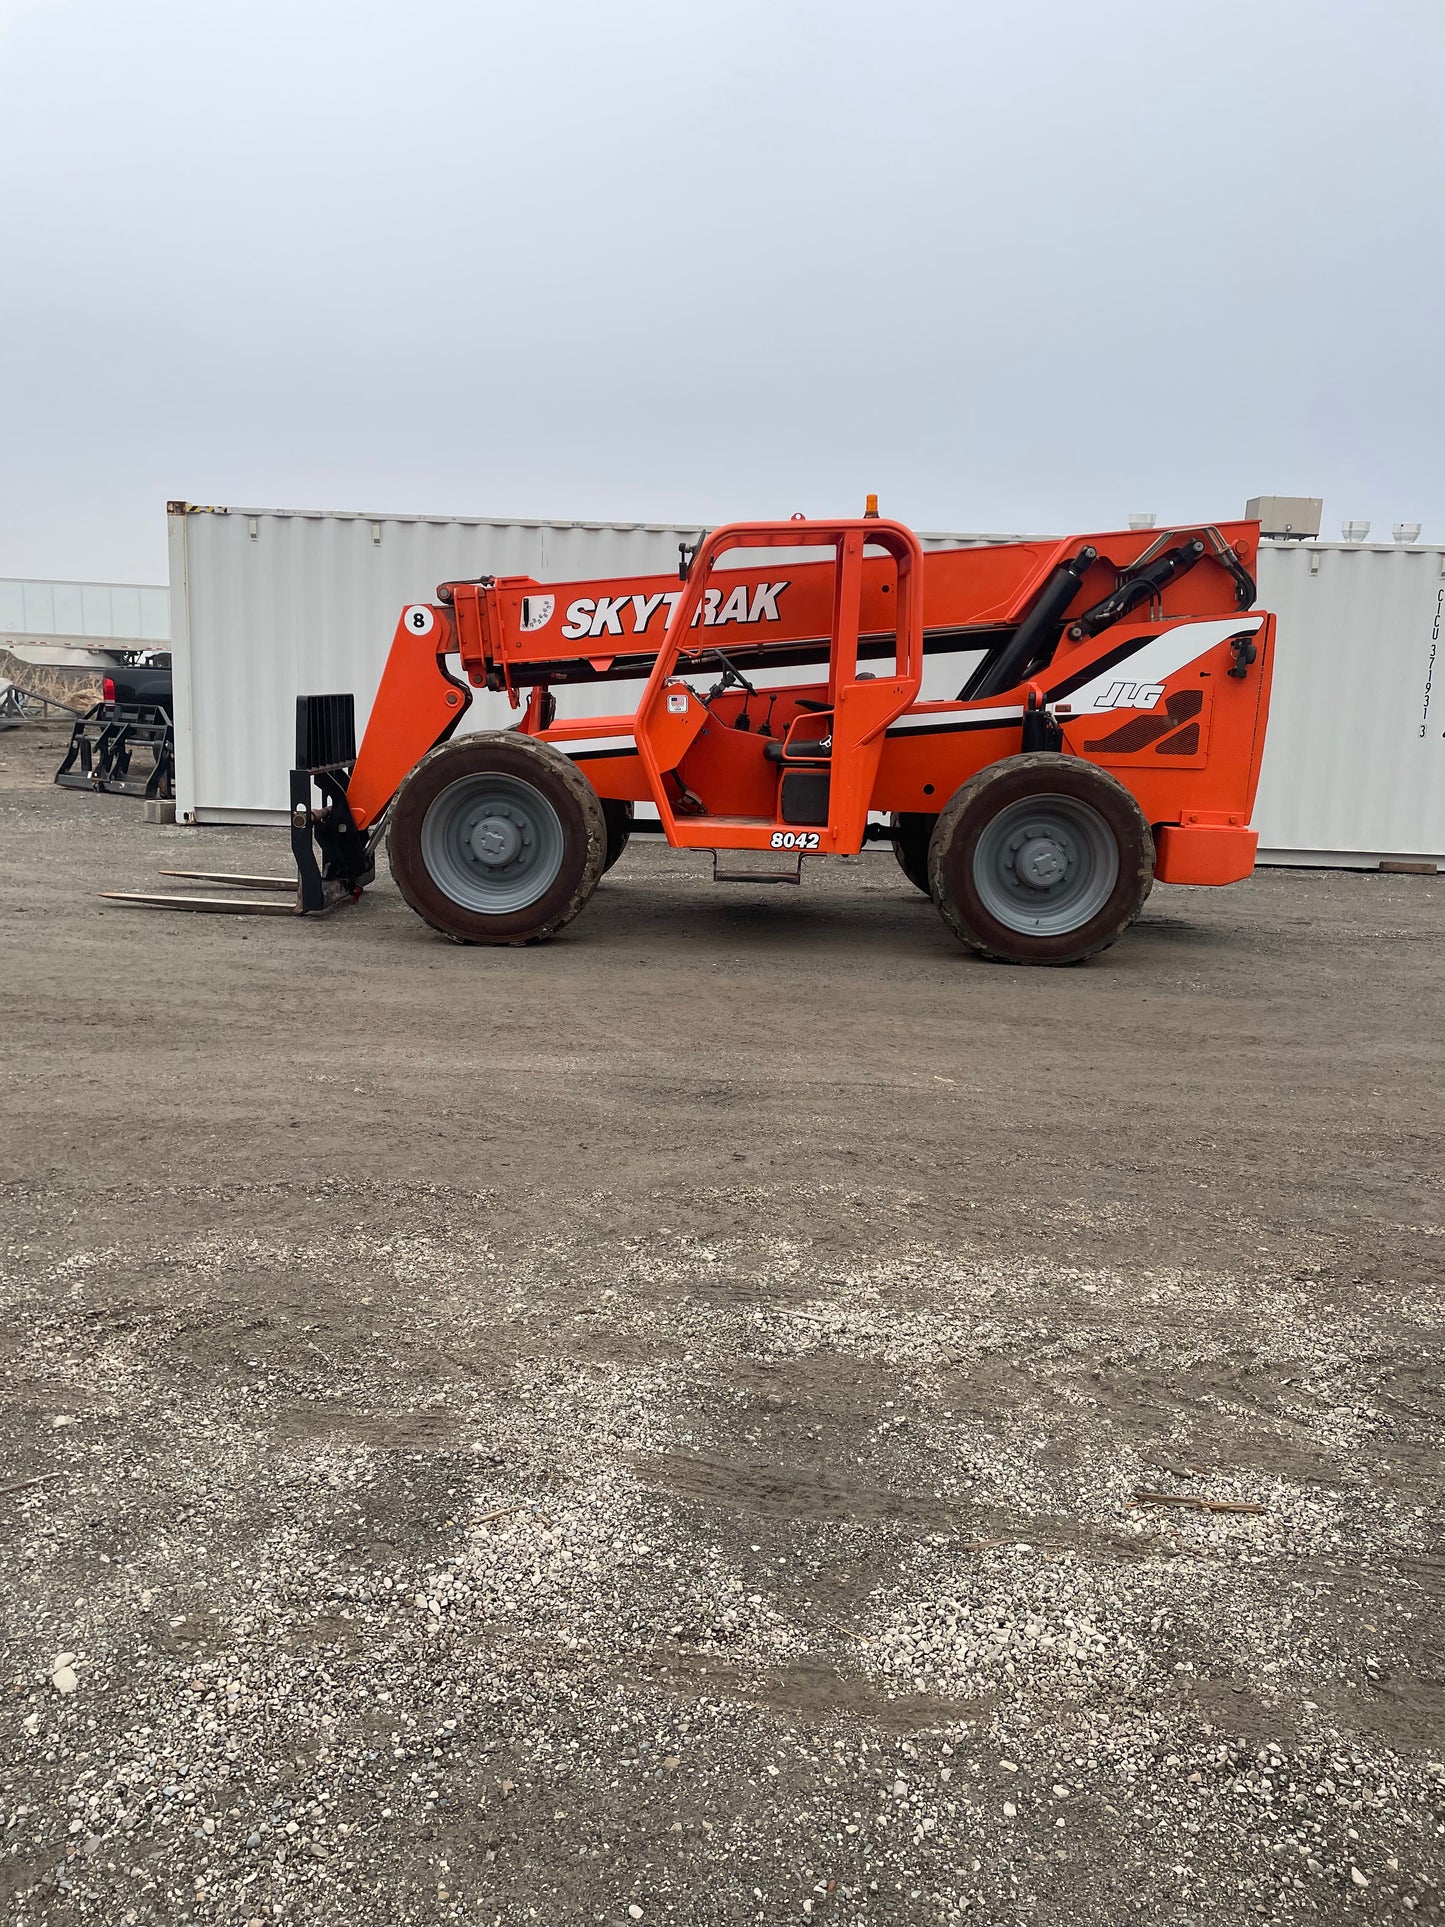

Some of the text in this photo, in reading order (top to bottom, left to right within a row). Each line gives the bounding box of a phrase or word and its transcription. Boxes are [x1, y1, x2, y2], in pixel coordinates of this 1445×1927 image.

[413, 612, 425, 629] 8
[561, 581, 791, 640] SKYTRAK
[1423, 644, 1436, 720] 371931
[1093, 682, 1167, 709] JLG
[1419, 725, 1426, 738] 3
[770, 831, 821, 850] 8042
